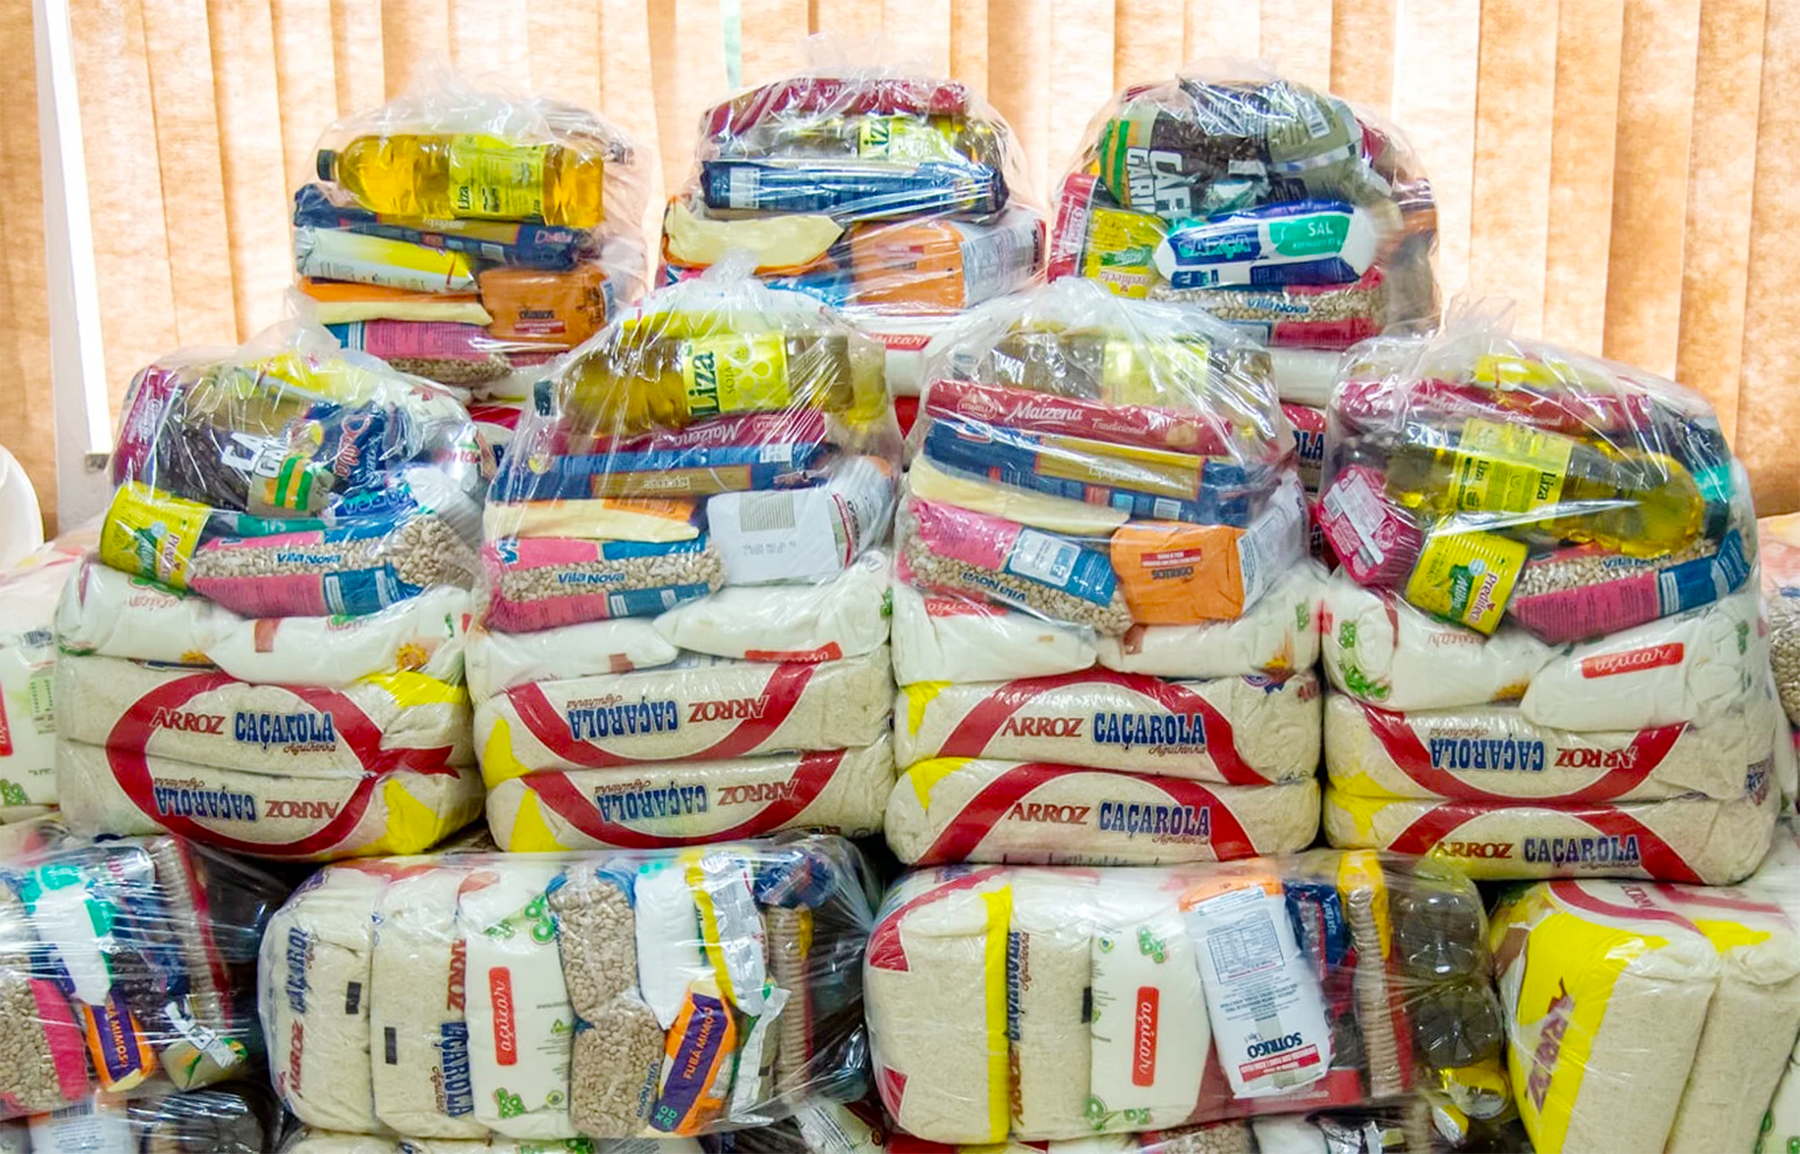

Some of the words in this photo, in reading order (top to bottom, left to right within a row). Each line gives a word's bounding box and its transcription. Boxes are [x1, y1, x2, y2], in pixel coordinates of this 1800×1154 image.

[1307, 221, 1334, 237] SAL
[690, 350, 722, 418] Liza
[1003, 400, 1083, 423] Maizena
[1536, 471, 1557, 501] Liza
[557, 572, 587, 585] Vila
[587, 571, 625, 585] Nova
[960, 570, 999, 595] Nova
[567, 695, 679, 741] CAÇAROLA
[688, 693, 769, 723] ARROZ
[150, 708, 225, 735] ARROZ
[233, 710, 335, 752] CAÇAROLA
[1000, 716, 1084, 738] ARROZ
[1093, 712, 1207, 751] CAÇAROLA
[1429, 731, 1545, 772] CAÇAROLA
[1555, 744, 1639, 770] ARROZ
[154, 783, 257, 822] CAÇAROLA
[264, 801, 340, 820] ARROZ
[595, 780, 709, 823] CAÇAROLA
[717, 778, 799, 806] ARROZ
[1007, 801, 1091, 826] ARROZ
[1098, 799, 1212, 839] CAÇAROLA
[1434, 840, 1514, 860] ARROZ
[1523, 836, 1640, 869] CAÇAROLA
[446, 939, 468, 1013] ARROZ
[494, 979, 514, 1052] açúcar
[683, 1049, 702, 1081] FUBÁ
[697, 1005, 714, 1050] MIMOSO
[1136, 1001, 1156, 1075] açúcar
[1247, 1031, 1303, 1060] SOTRIGO
